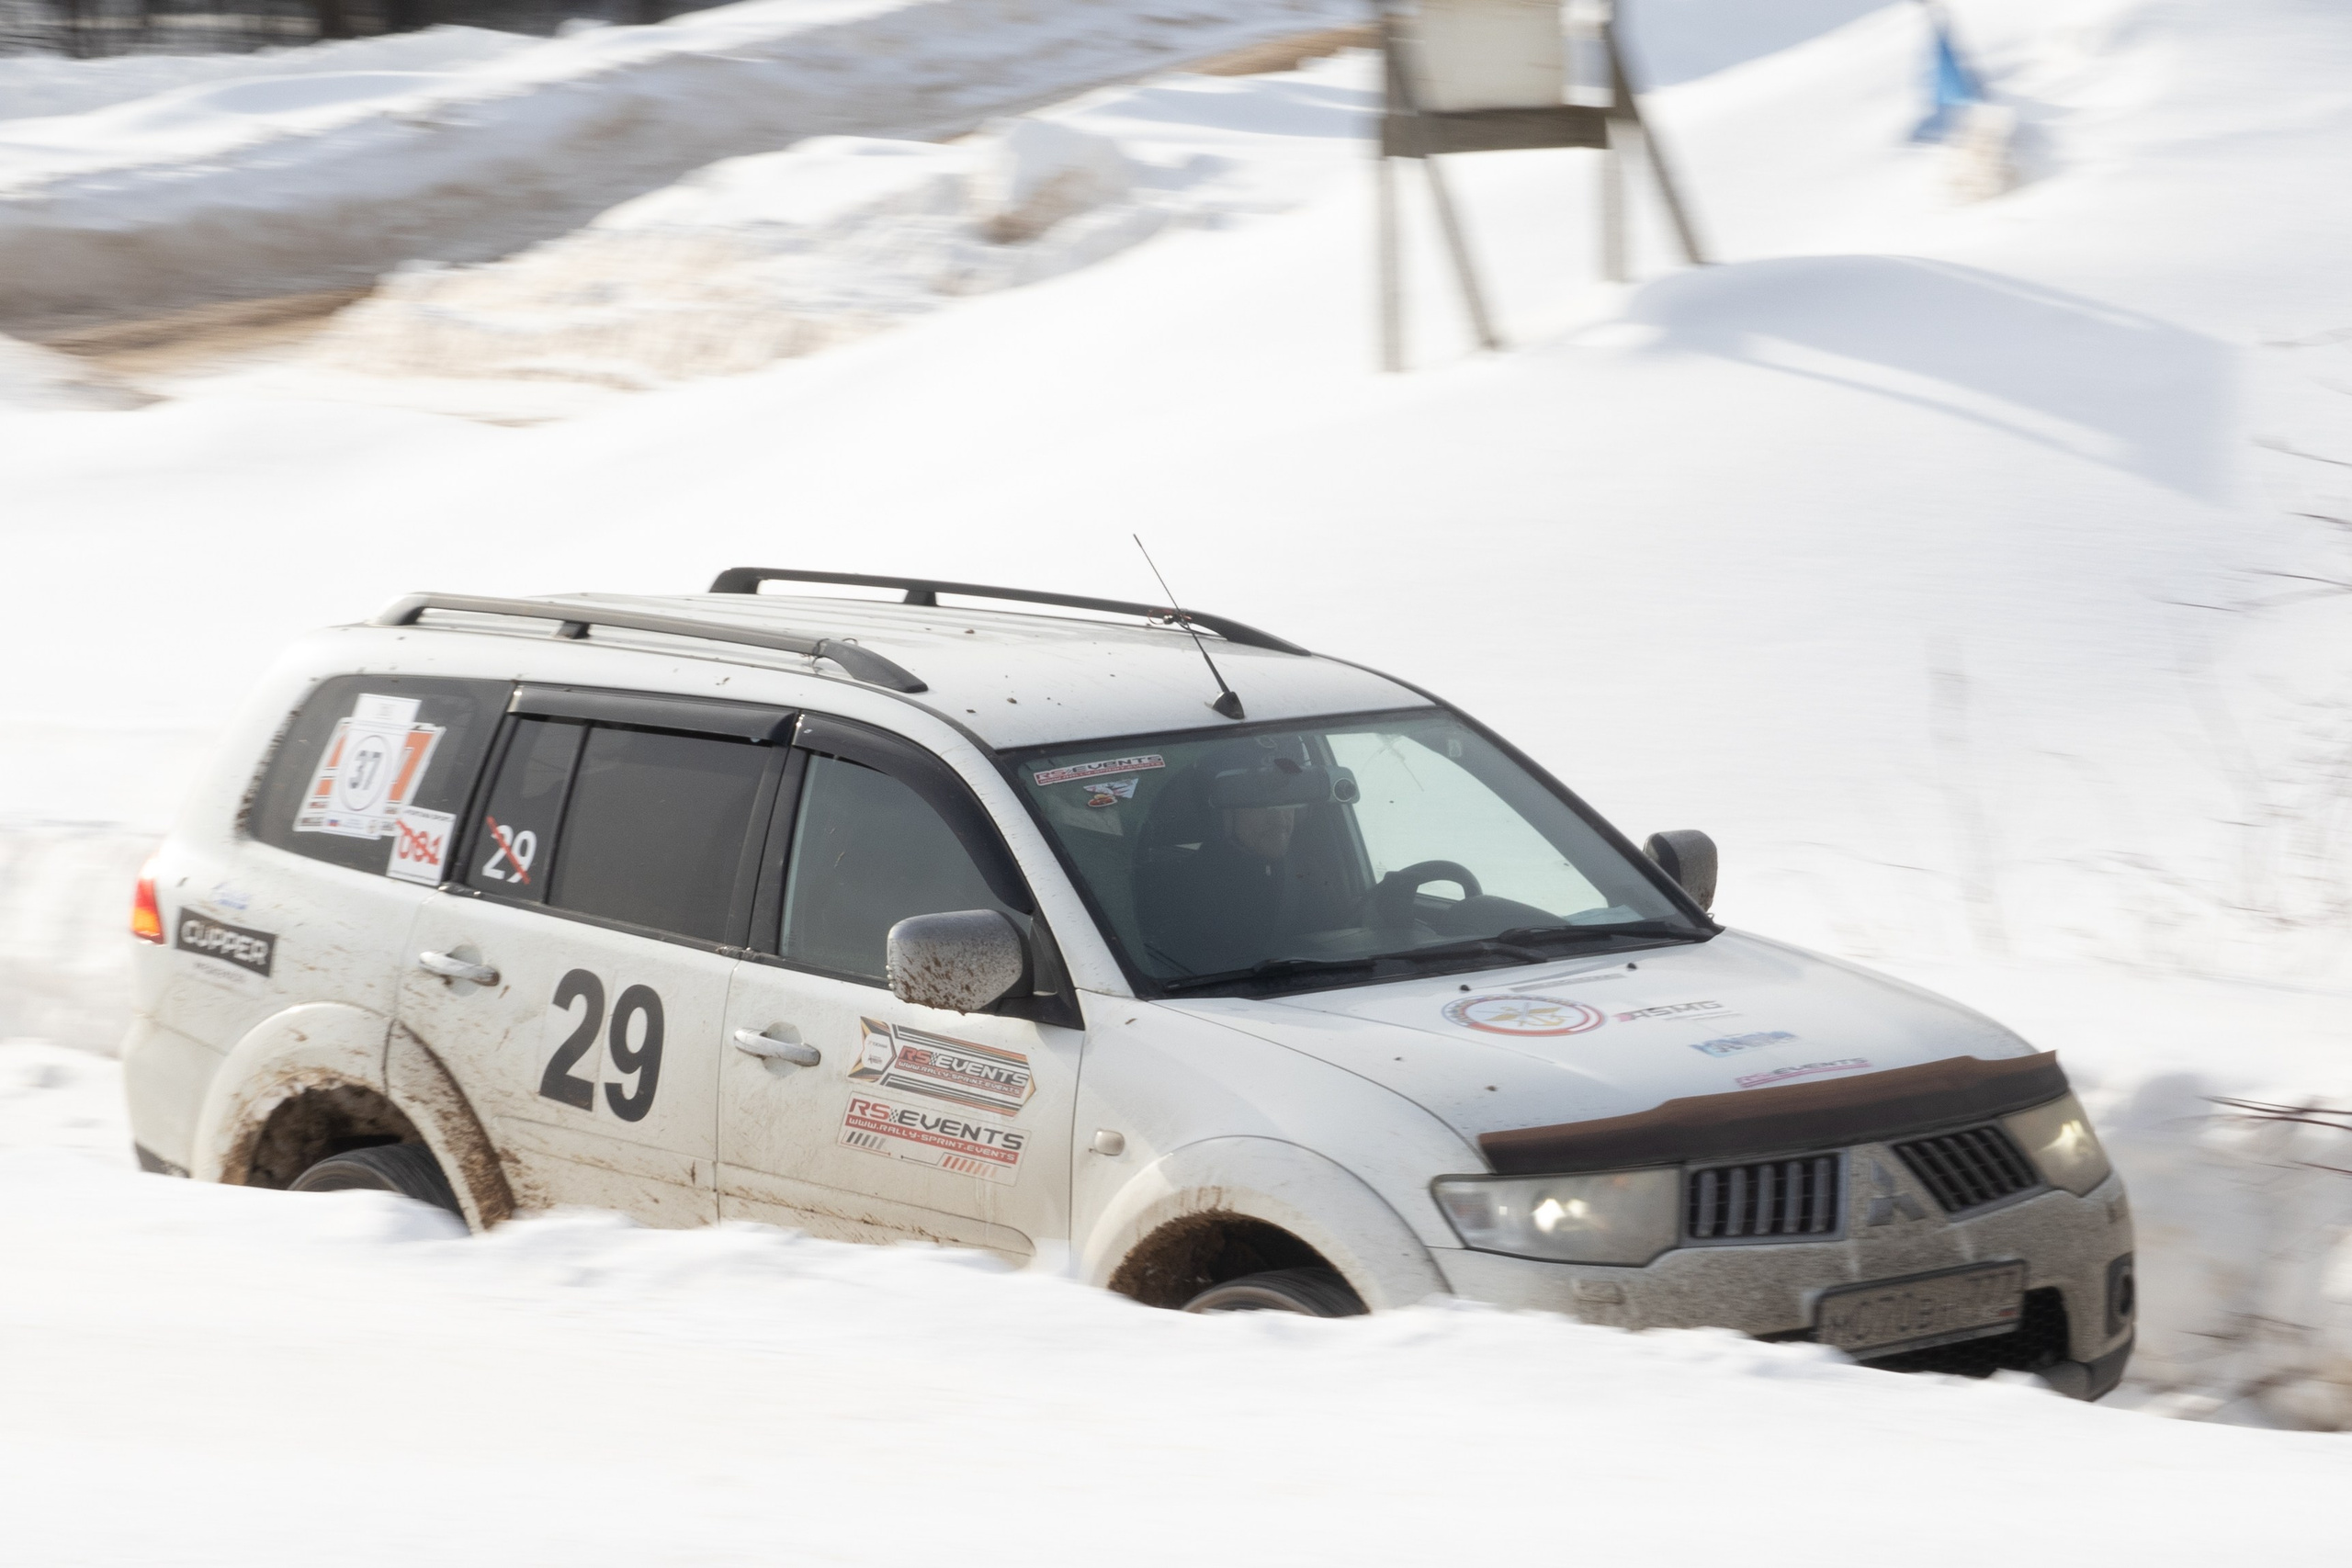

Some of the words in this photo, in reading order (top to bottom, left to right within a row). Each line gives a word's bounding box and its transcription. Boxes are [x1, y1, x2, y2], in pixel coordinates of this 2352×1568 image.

[348, 750, 382, 791] 37
[482, 824, 537, 883] 29
[181, 919, 269, 965] CUPPER
[539, 968, 664, 1122] 29
[848, 1116, 1016, 1162] WWW.RALLY-SPRINT.EVENTS
[897, 1109, 1025, 1151] EVENTS
